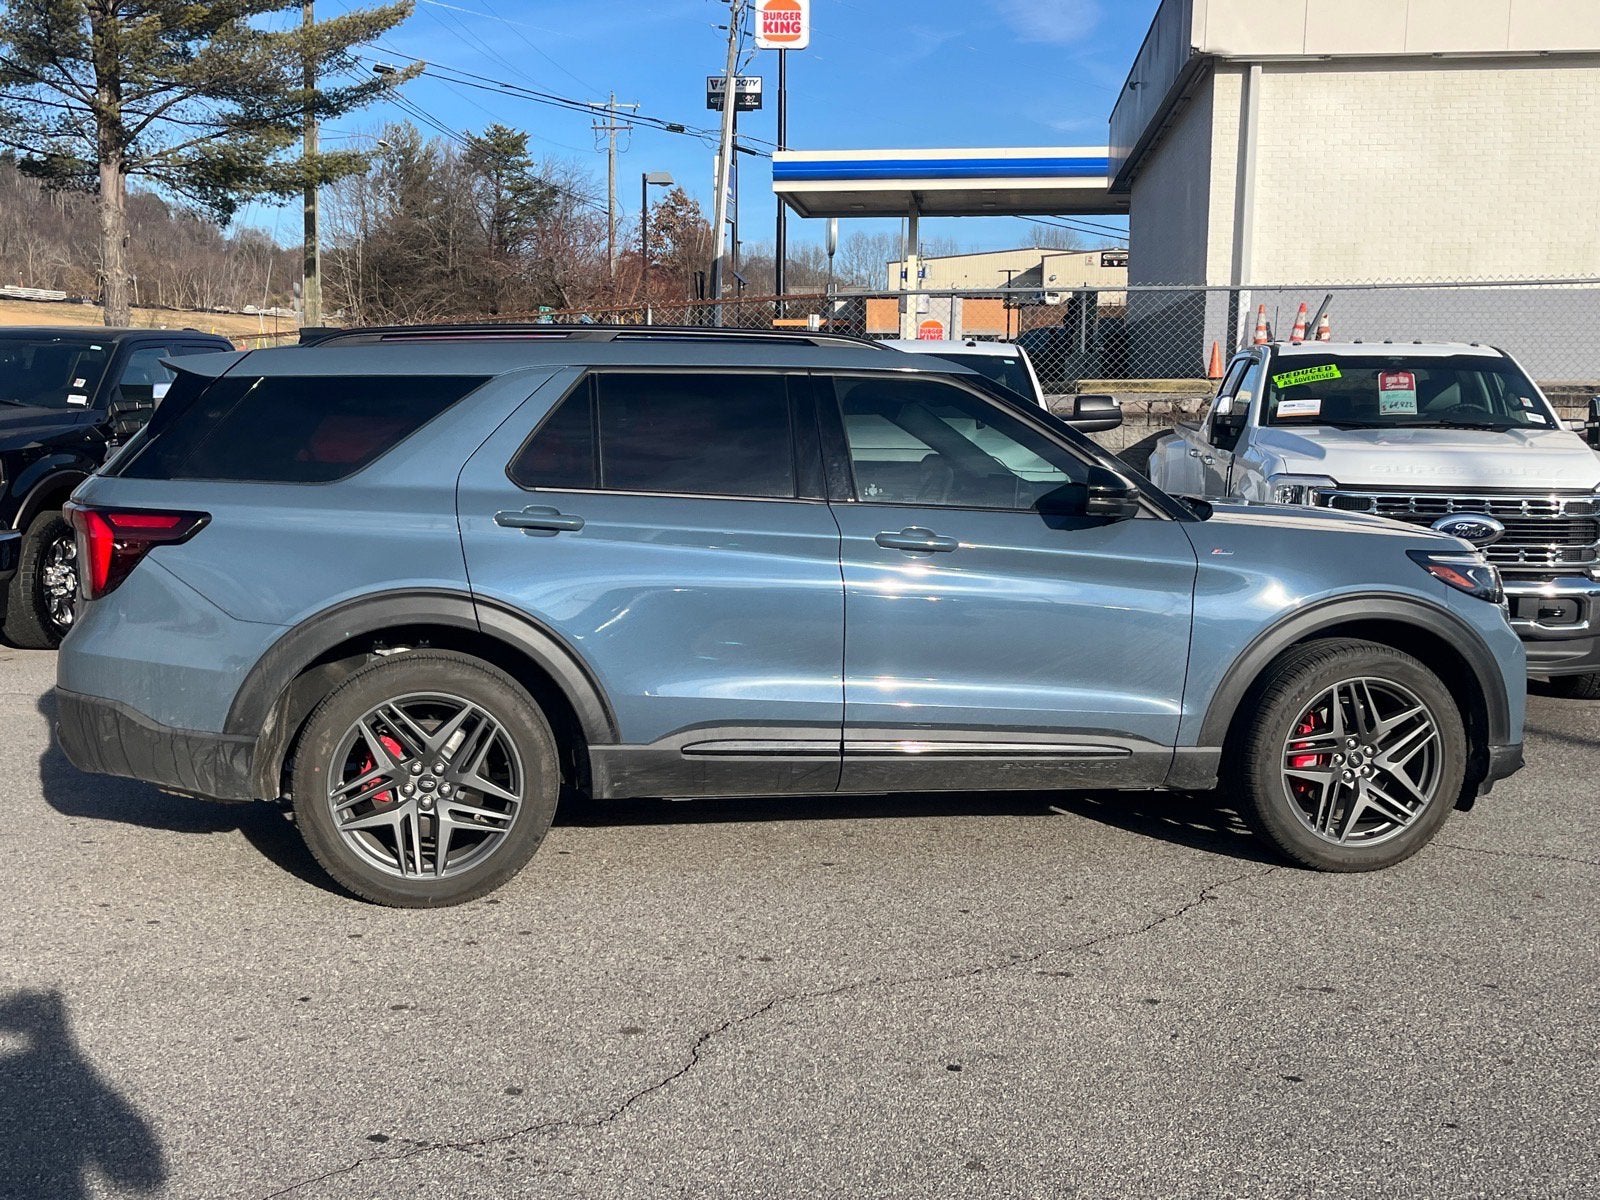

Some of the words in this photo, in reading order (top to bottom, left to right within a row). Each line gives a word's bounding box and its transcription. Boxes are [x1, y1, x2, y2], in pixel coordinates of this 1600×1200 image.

[763, 12, 801, 20] BURGER
[763, 21, 801, 33] KING
[1277, 365, 1332, 381] REDUCED
[1294, 372, 1335, 384] ADVERTISED
[1452, 522, 1487, 538] Ford
